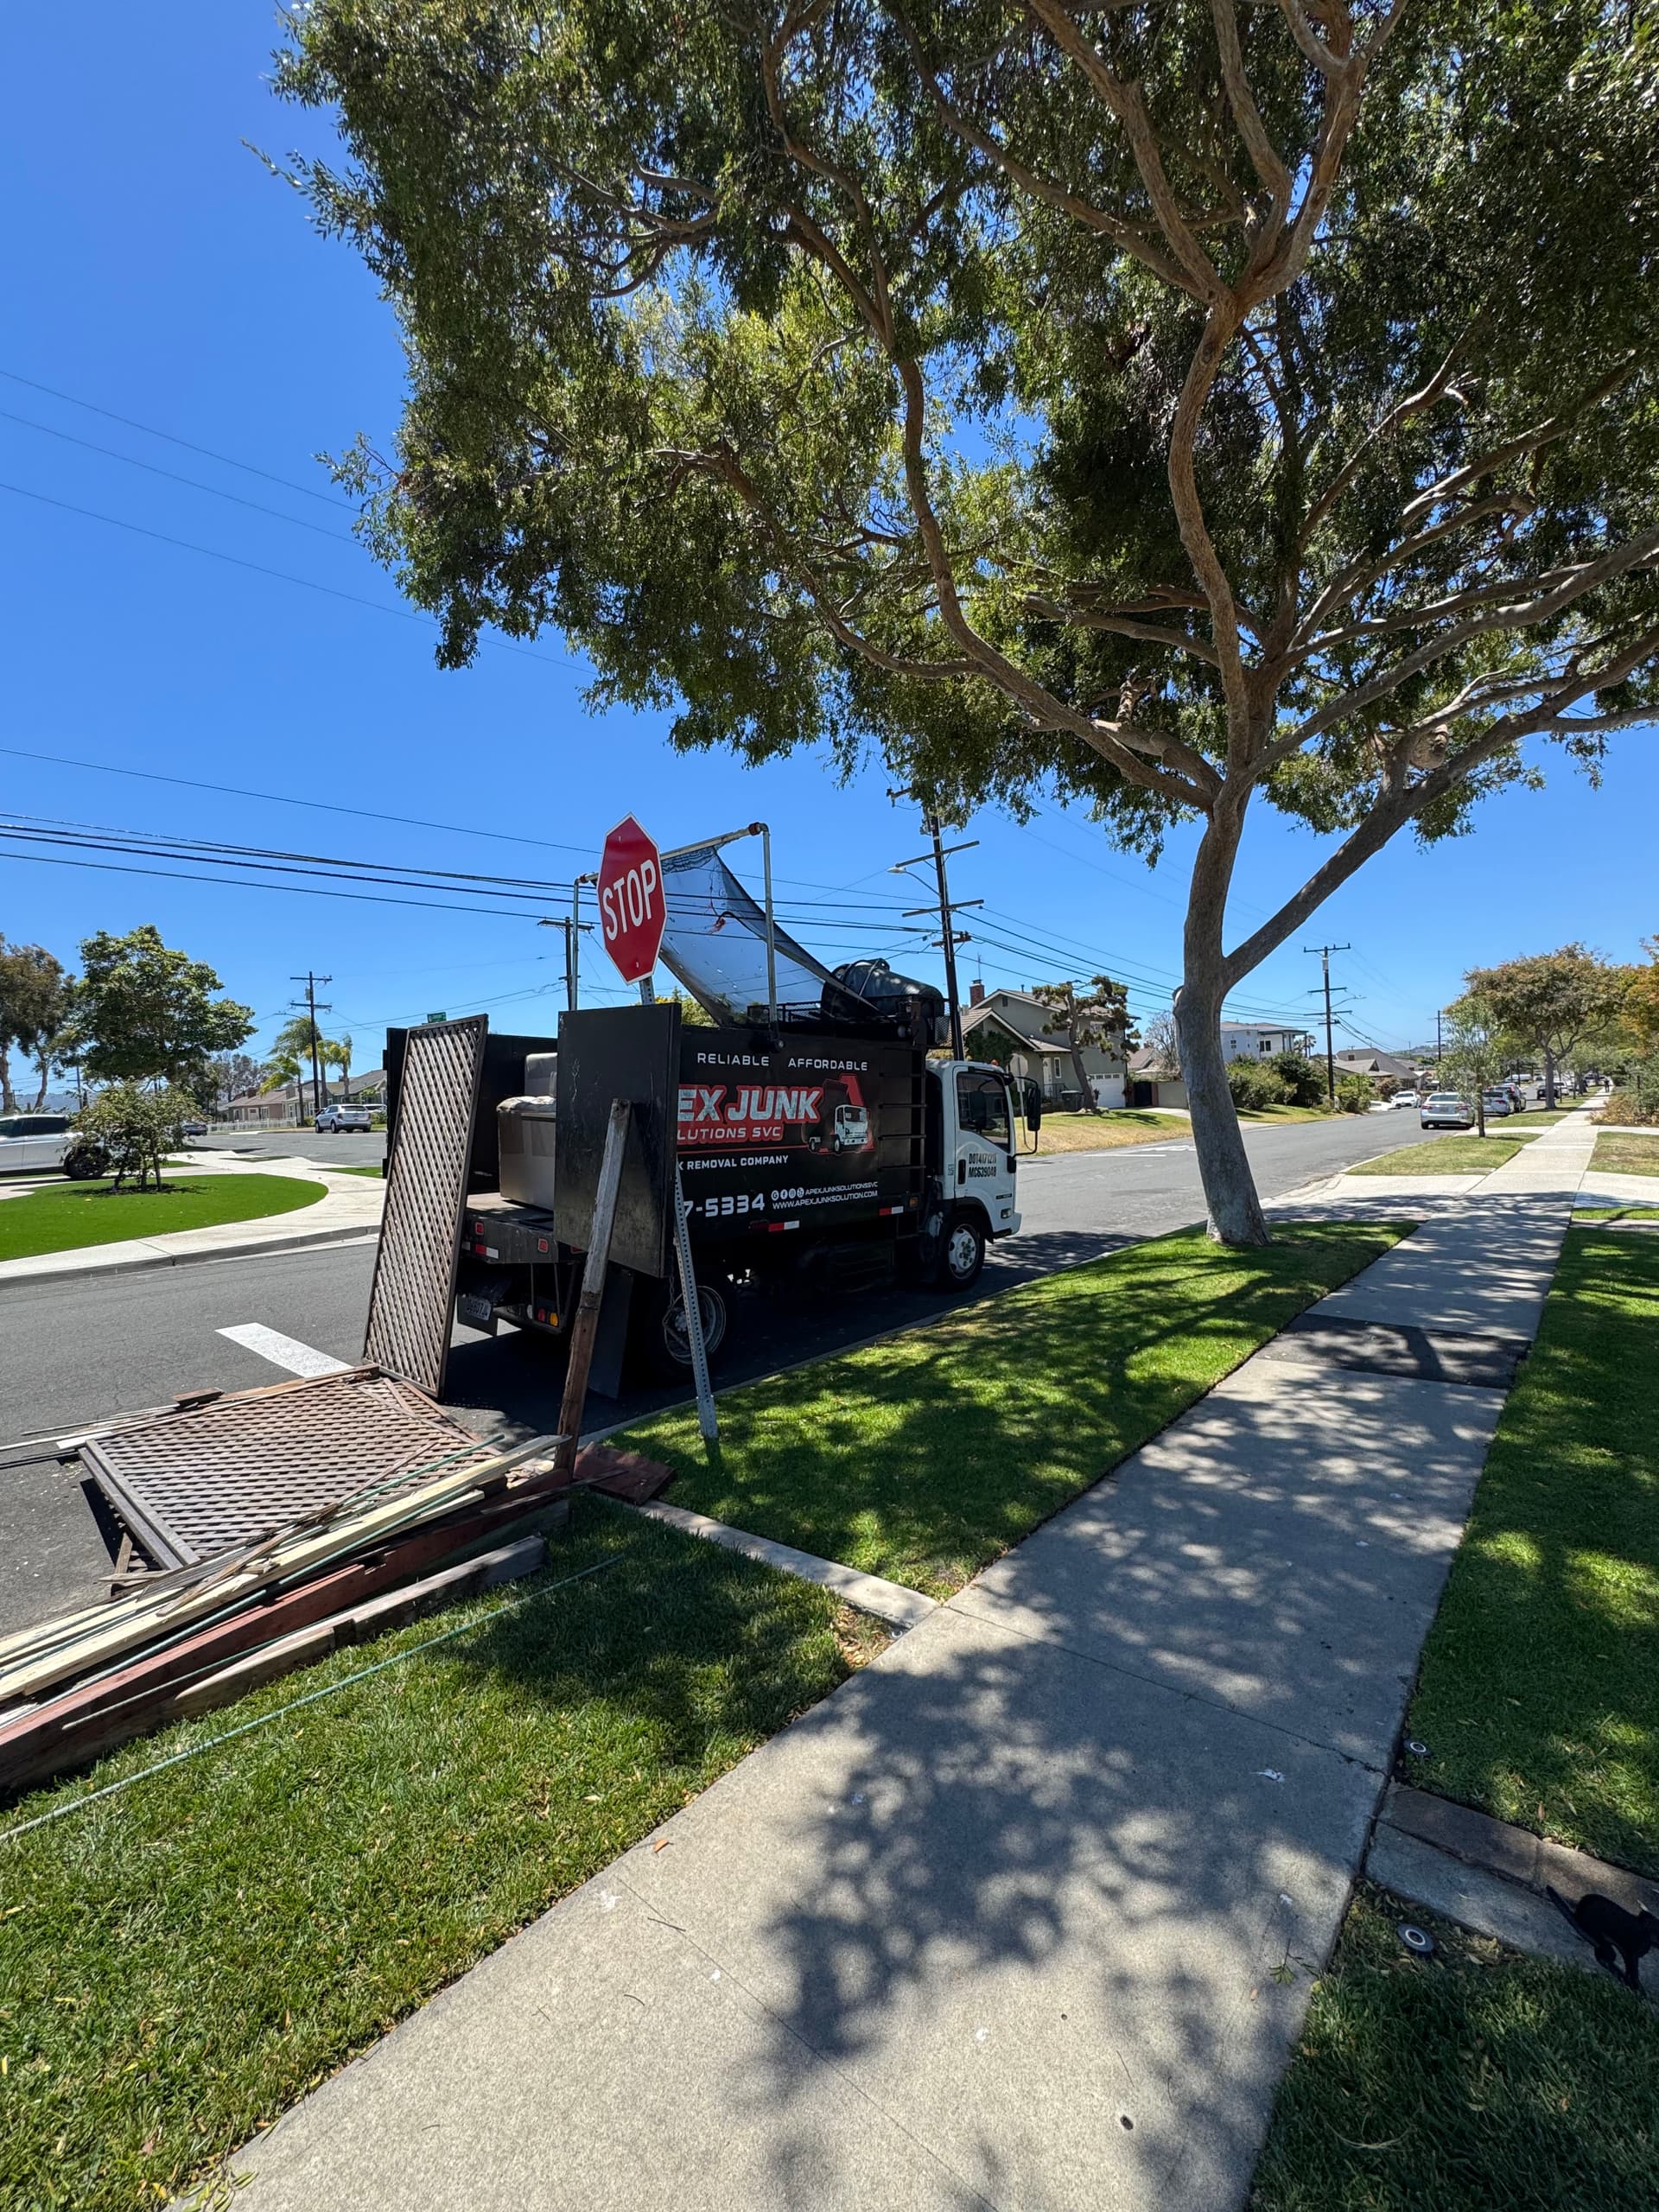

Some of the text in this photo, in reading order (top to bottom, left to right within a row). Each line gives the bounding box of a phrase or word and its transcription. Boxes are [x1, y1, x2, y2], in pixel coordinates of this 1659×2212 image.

[602, 859, 657, 941] STOP
[697, 1052, 868, 1071] RELIABLE AFFORDABLE
[677, 1088, 821, 1122] EX JUNK
[677, 1125, 782, 1141] LUTIONS SVC
[687, 1157, 738, 1171] REMOVAL
[740, 1154, 789, 1166] COMPANY
[805, 1181, 879, 1195] APEXJUNKSOLUTIONSSVC
[772, 1190, 879, 1210] WWW.APEXJUNKSOLUTION.COM
